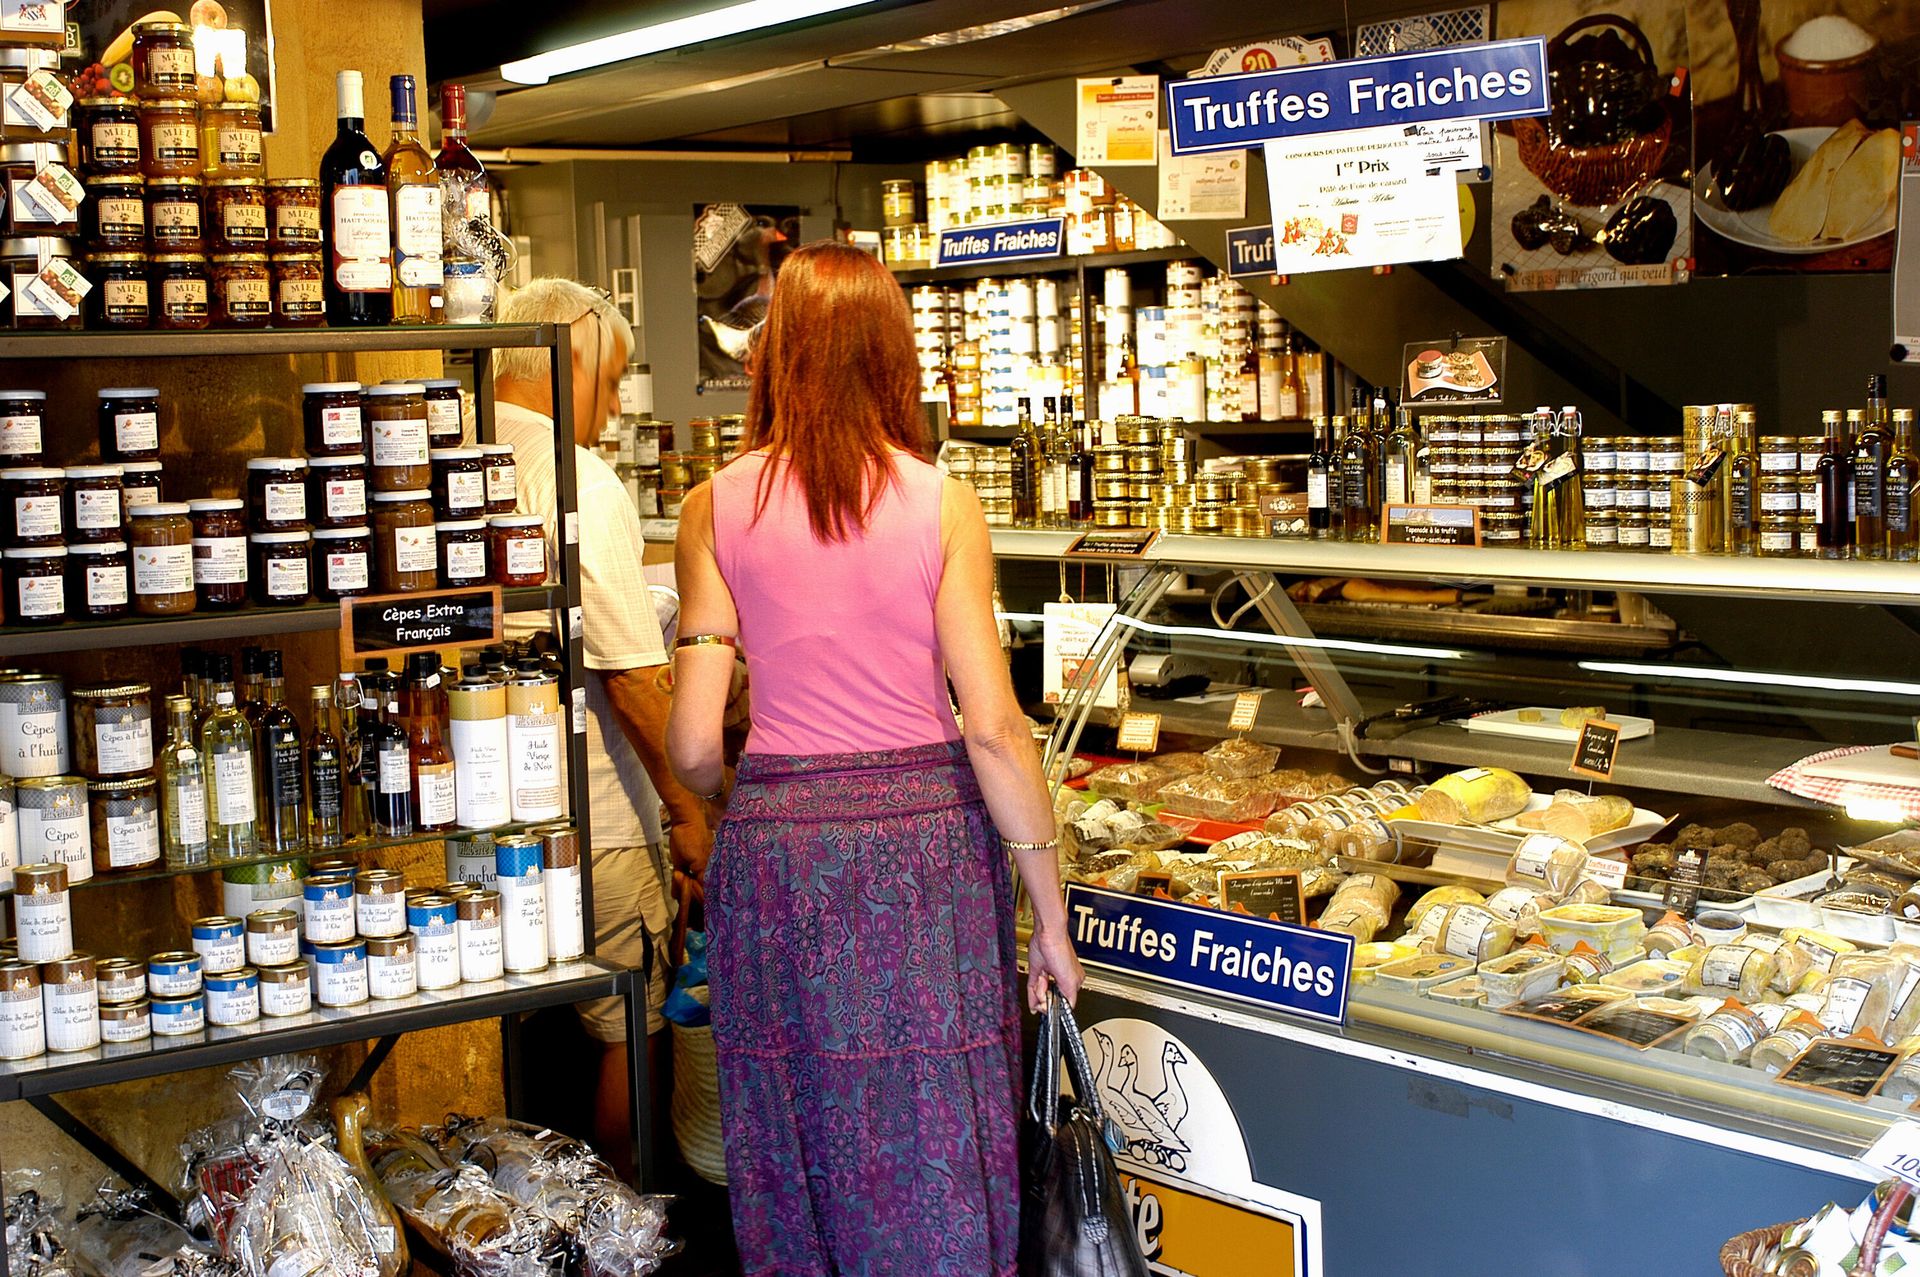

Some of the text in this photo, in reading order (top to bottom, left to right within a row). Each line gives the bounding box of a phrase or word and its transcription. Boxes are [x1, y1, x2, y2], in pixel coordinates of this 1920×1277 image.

[162, 53, 189, 64] MIEL
[1244, 51, 1273, 72] 20
[1183, 64, 1533, 134] Truffes Fraiches
[104, 128, 132, 138] MIEL
[163, 128, 191, 139] MIEL
[229, 133, 255, 143] MIEL
[1358, 159, 1390, 174] Prix
[110, 203, 139, 214] MIEL
[162, 206, 192, 217] MIEL
[235, 209, 262, 220] MIEL
[287, 209, 315, 220] MIEL
[942, 228, 1057, 257] Truffes Fraiches
[1569, 267, 1617, 287] Périgord
[1619, 267, 1639, 285] qui
[1641, 266, 1668, 280] veut
[116, 284, 144, 295] MIEL
[174, 284, 202, 294] MIEL
[238, 283, 265, 294] MIEL
[291, 283, 318, 294] MIEL
[382, 604, 464, 624] Cèpes Extra
[396, 623, 451, 642] Français
[21, 721, 56, 740] Cèpes
[101, 732, 124, 744] Cèpes
[18, 741, 65, 759] à l'huile
[44, 827, 80, 843] Cèpes
[112, 825, 135, 837] Cèpes
[54, 847, 87, 864] l'huile
[1073, 904, 1336, 998] Truffes Fraiches
